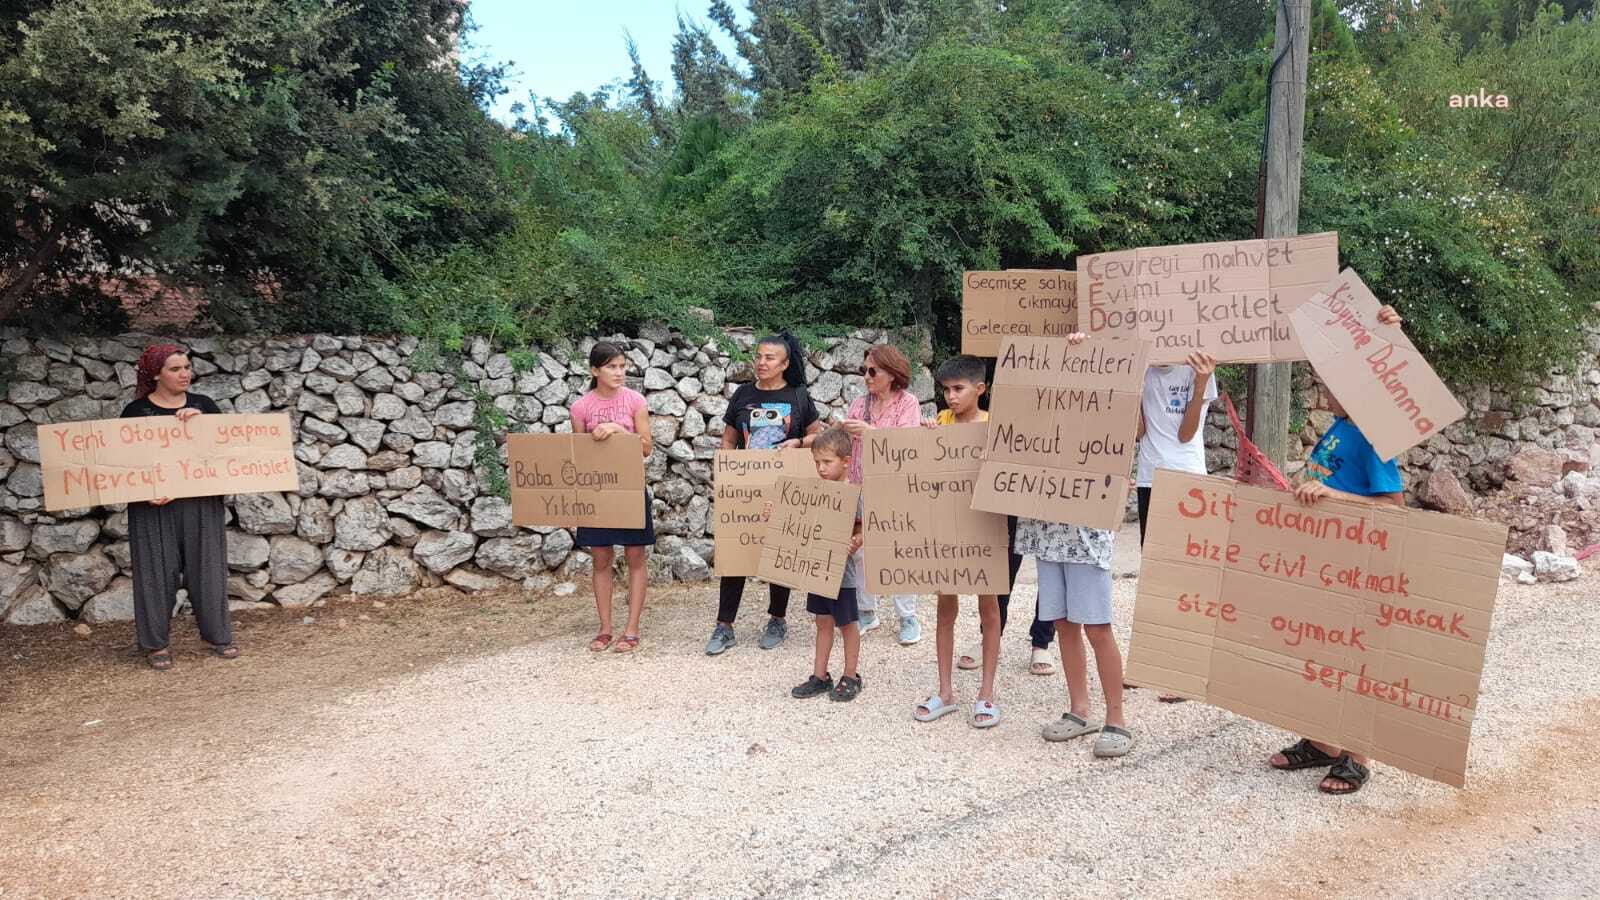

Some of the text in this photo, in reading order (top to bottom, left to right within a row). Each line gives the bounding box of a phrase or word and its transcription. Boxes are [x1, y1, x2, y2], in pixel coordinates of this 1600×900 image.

[1087, 241, 1293, 281] Çevreyi mahvet
[1089, 274, 1222, 307] Evimi yık
[1089, 294, 1283, 333] Doğayı katlet
[1323, 281, 1372, 350] Köyüme
[1156, 324, 1290, 348] nasıl olumlu
[1001, 343, 1134, 374] Antik kentleri
[1366, 343, 1434, 435] Dokunma
[53, 420, 280, 452] Yeni Otoyol yapma
[993, 423, 1124, 465] Mevcut yolu
[871, 437, 919, 472] Myra
[63, 457, 291, 495] Mevcut Yolu Genişlet
[514, 460, 553, 488] Baba
[907, 473, 974, 499] Hoyran
[718, 483, 762, 503] dünya
[780, 481, 842, 515] Köyümü
[782, 514, 823, 546] ikiye
[867, 511, 916, 533] Antik
[1178, 487, 1388, 551] Sit alanında
[894, 537, 992, 560] kentlerime
[1186, 533, 1241, 563] bize
[879, 567, 989, 587] DOKUNMA
[1178, 593, 1367, 652] size oymak
[1375, 603, 1470, 639] yasak
